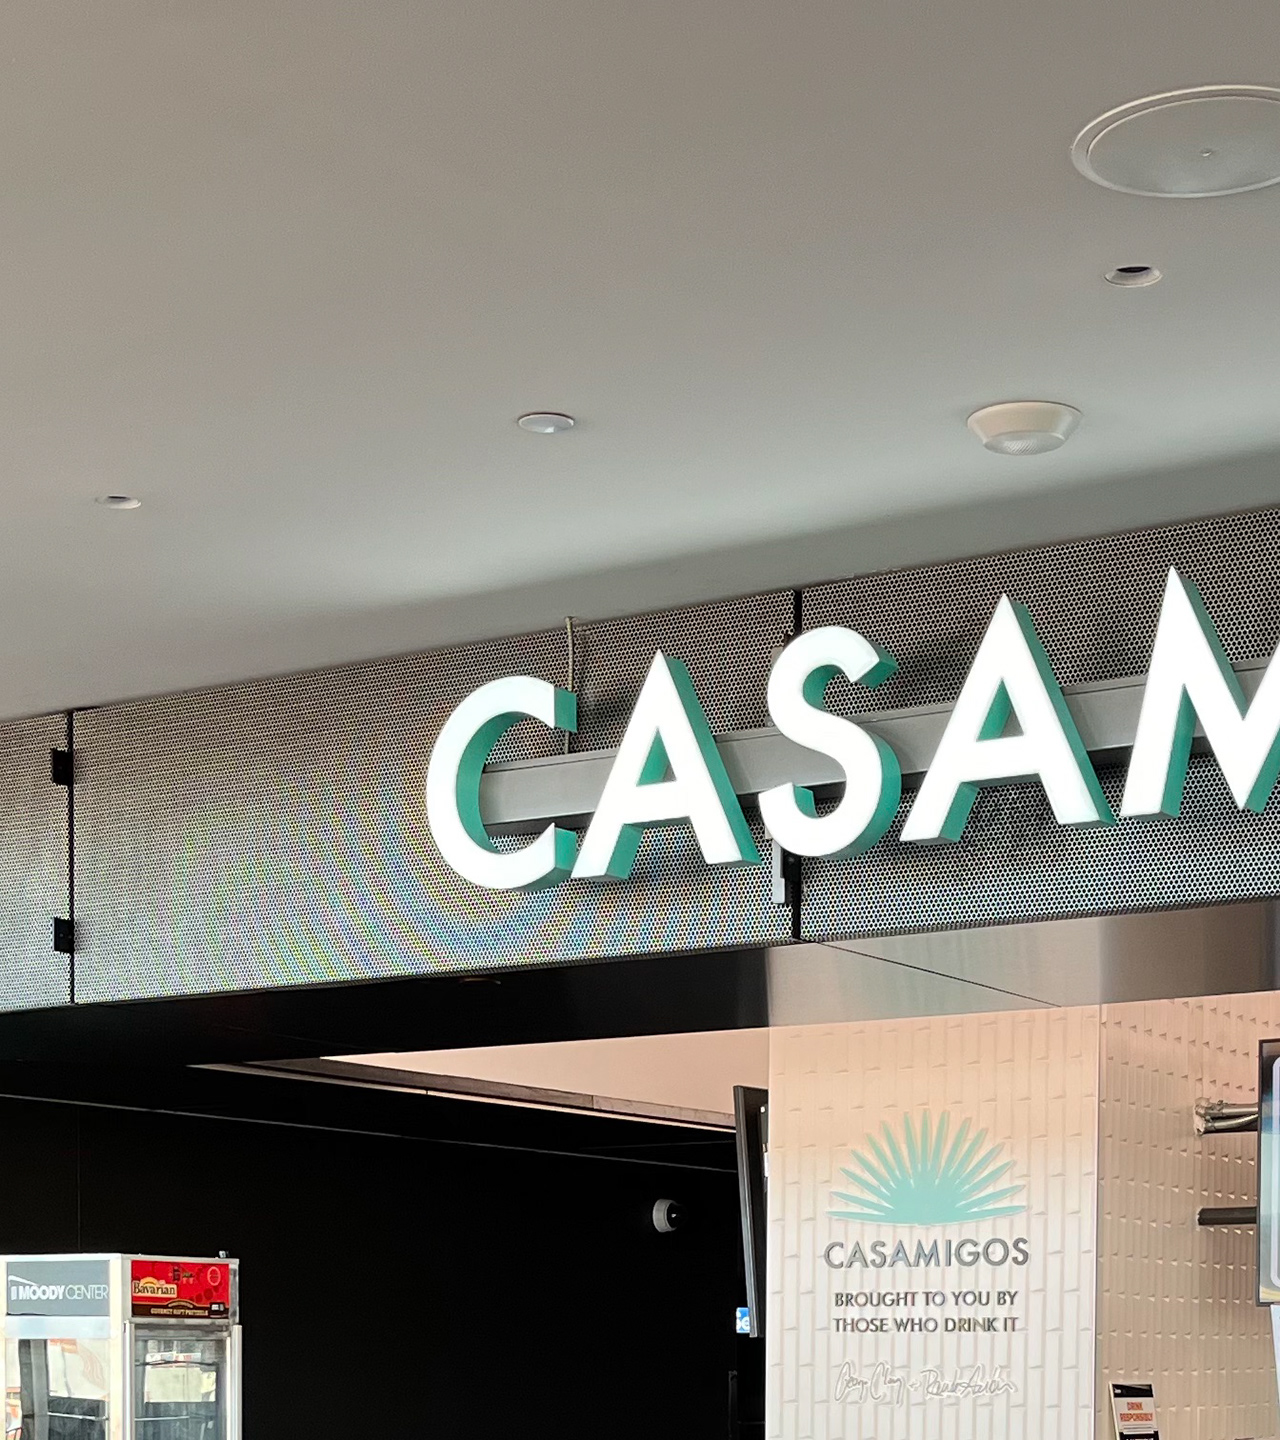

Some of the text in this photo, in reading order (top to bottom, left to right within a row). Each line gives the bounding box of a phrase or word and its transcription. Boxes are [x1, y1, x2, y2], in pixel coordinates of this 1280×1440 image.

[824, 1237, 1029, 1269] CASAMIGOS
[18, 1284, 109, 1300] MOODY CENTER
[133, 1281, 176, 1295] Bavarian
[834, 1290, 1019, 1307] BROUGHT TO YOU BY
[833, 1317, 1019, 1333] THOSE WHO DRINK IT
